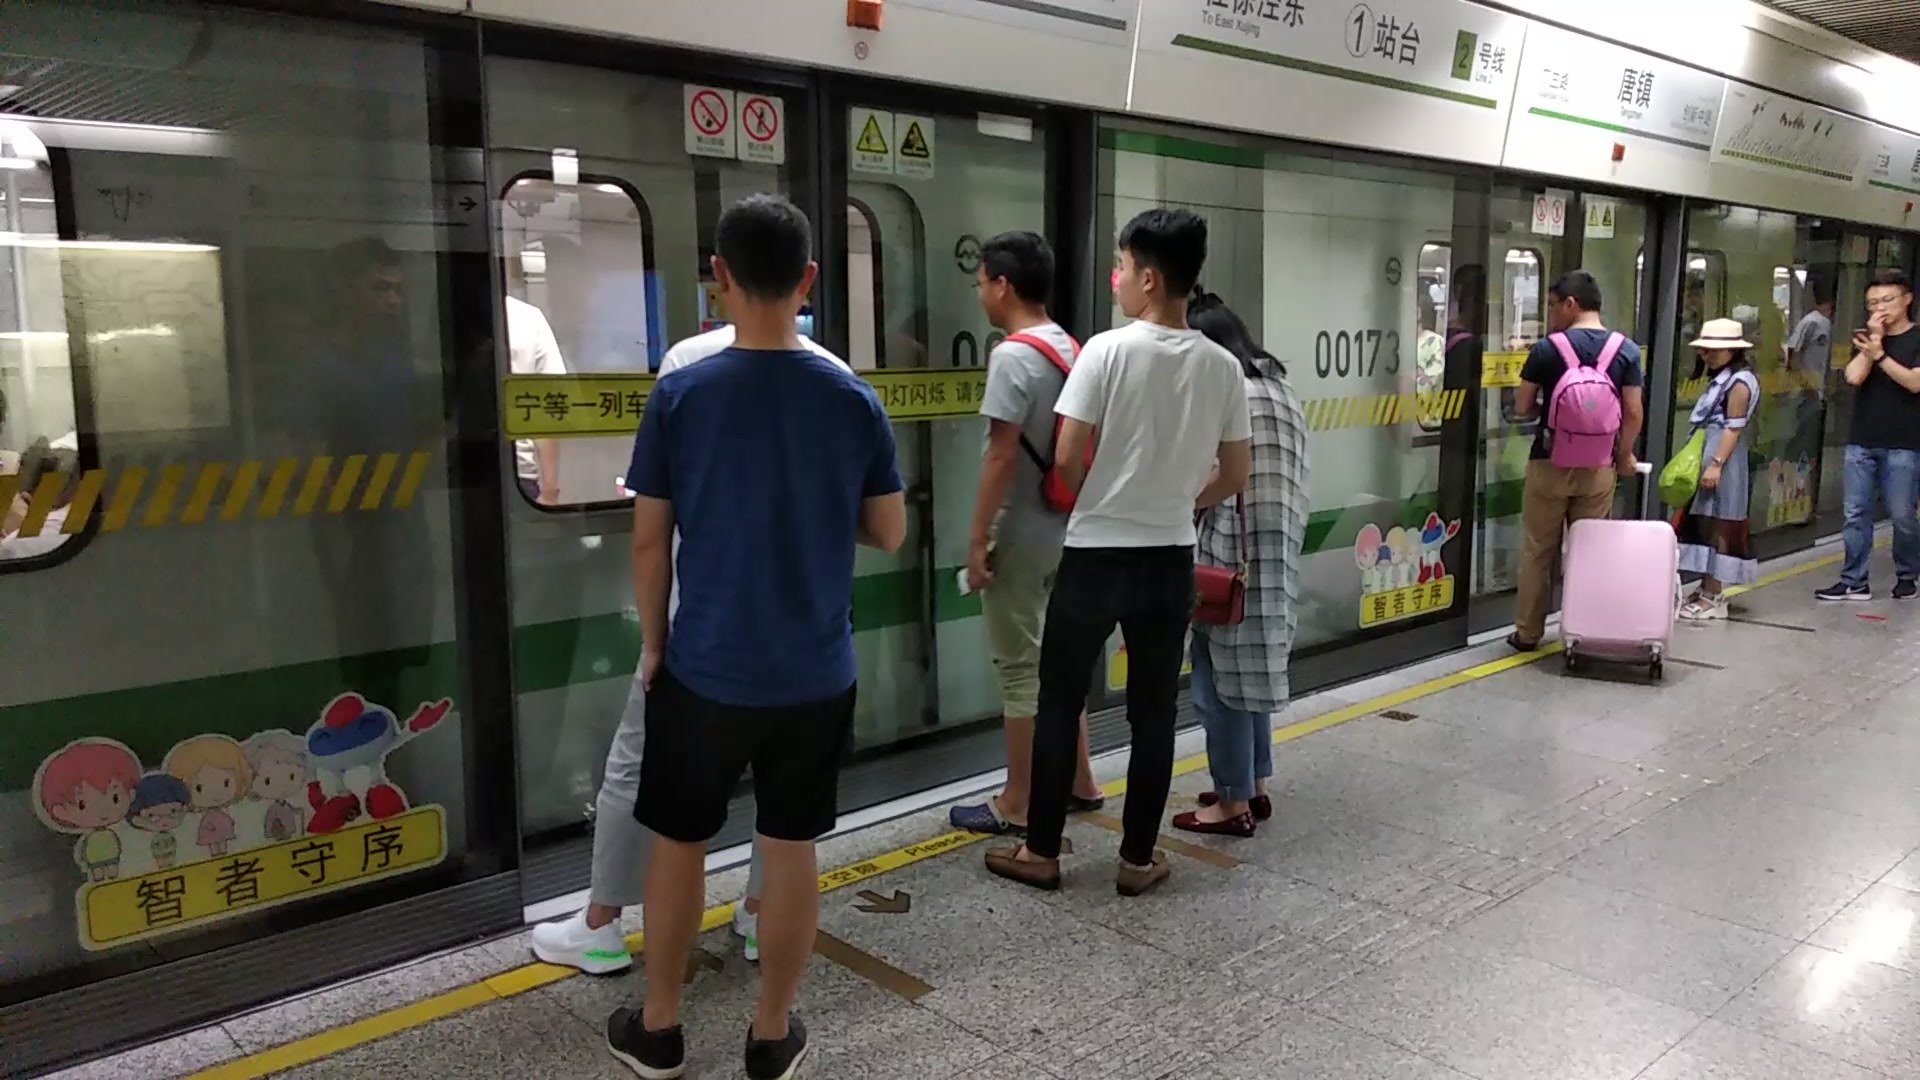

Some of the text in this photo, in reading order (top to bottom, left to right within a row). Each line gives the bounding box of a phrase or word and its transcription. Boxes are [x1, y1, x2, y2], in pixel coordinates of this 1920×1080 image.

[1202, 10, 1214, 25] To
[1215, 14, 1234, 29] East
[1206, 0, 1304, 27] 泾东
[1373, 15, 1420, 65] 站台
[1479, 42, 1505, 74] 号线
[1616, 67, 1655, 109] 唐镇
[1315, 329, 1400, 379] 00173
[515, 391, 648, 421] 宁等一列车
[1374, 582, 1442, 619] 智者守序
[903, 832, 967, 857] Please
[137, 824, 404, 926] 智者守序
